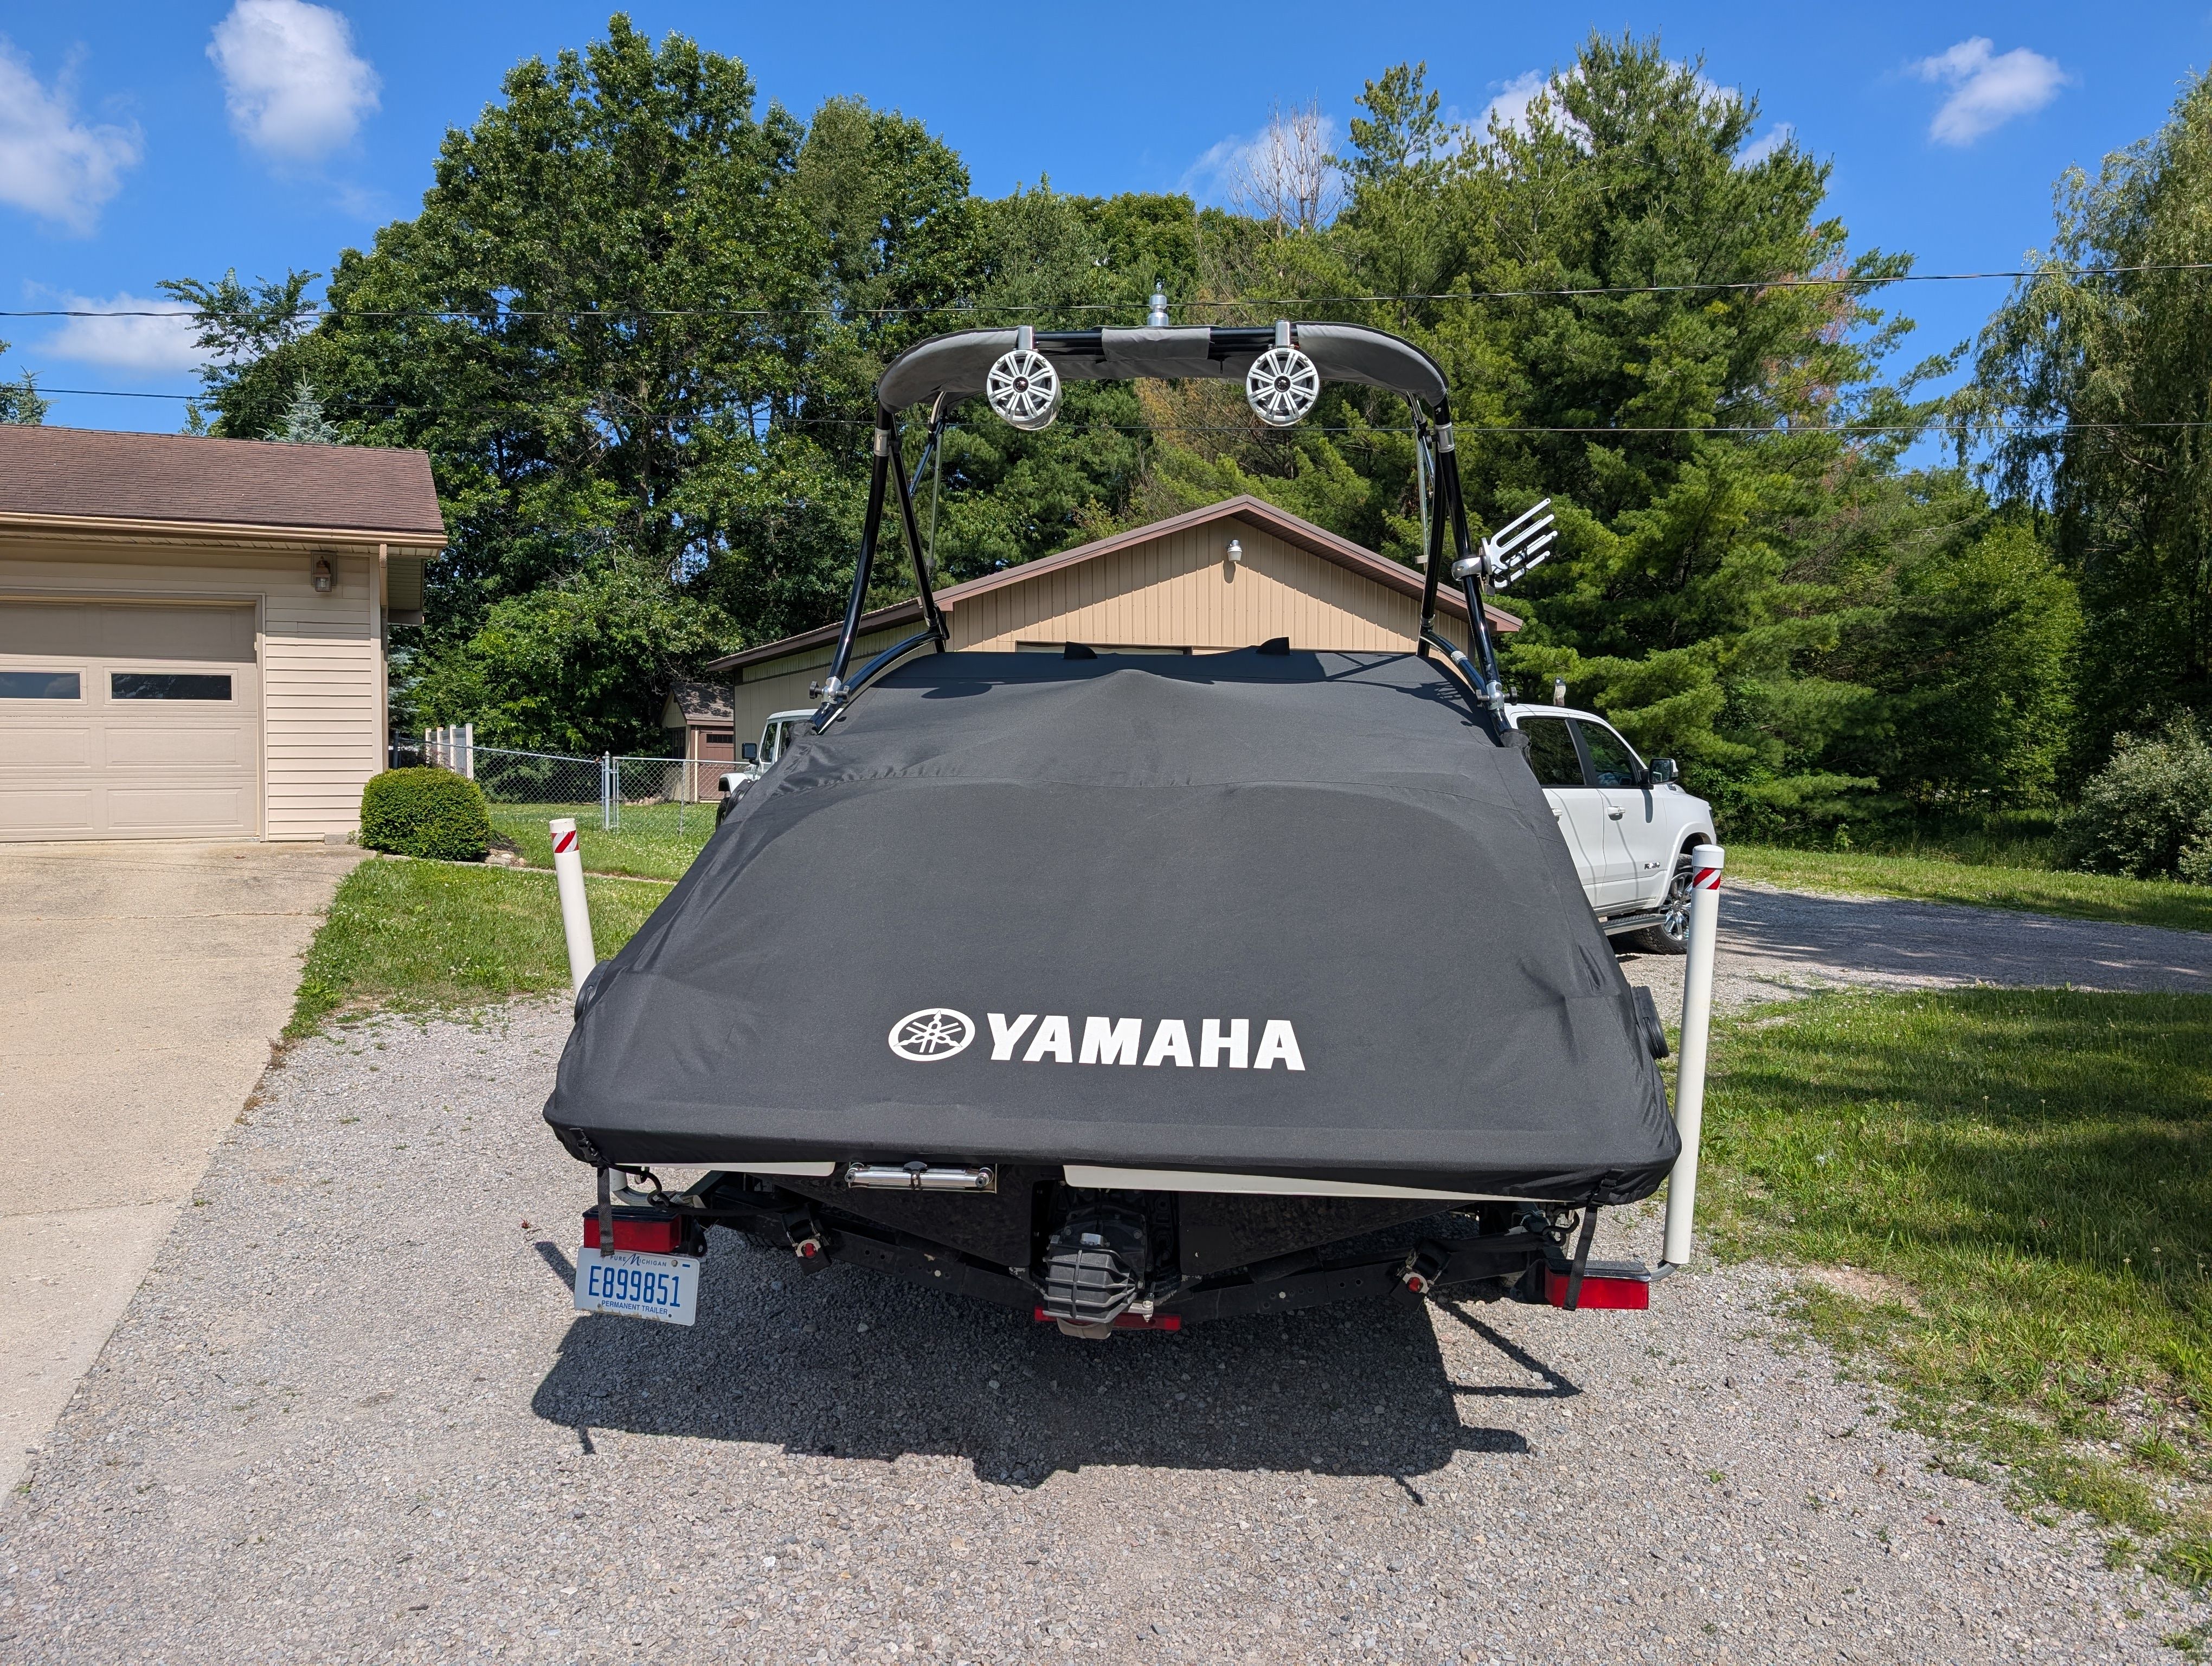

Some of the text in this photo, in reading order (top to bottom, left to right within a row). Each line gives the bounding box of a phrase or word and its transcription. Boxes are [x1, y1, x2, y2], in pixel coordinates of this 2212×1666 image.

[987, 1013, 1306, 1071] YAMAHA
[623, 1253, 667, 1267] MICHIGAN
[588, 1265, 681, 1308] E899851
[601, 1300, 668, 1315] PERMANENT TRAILER
